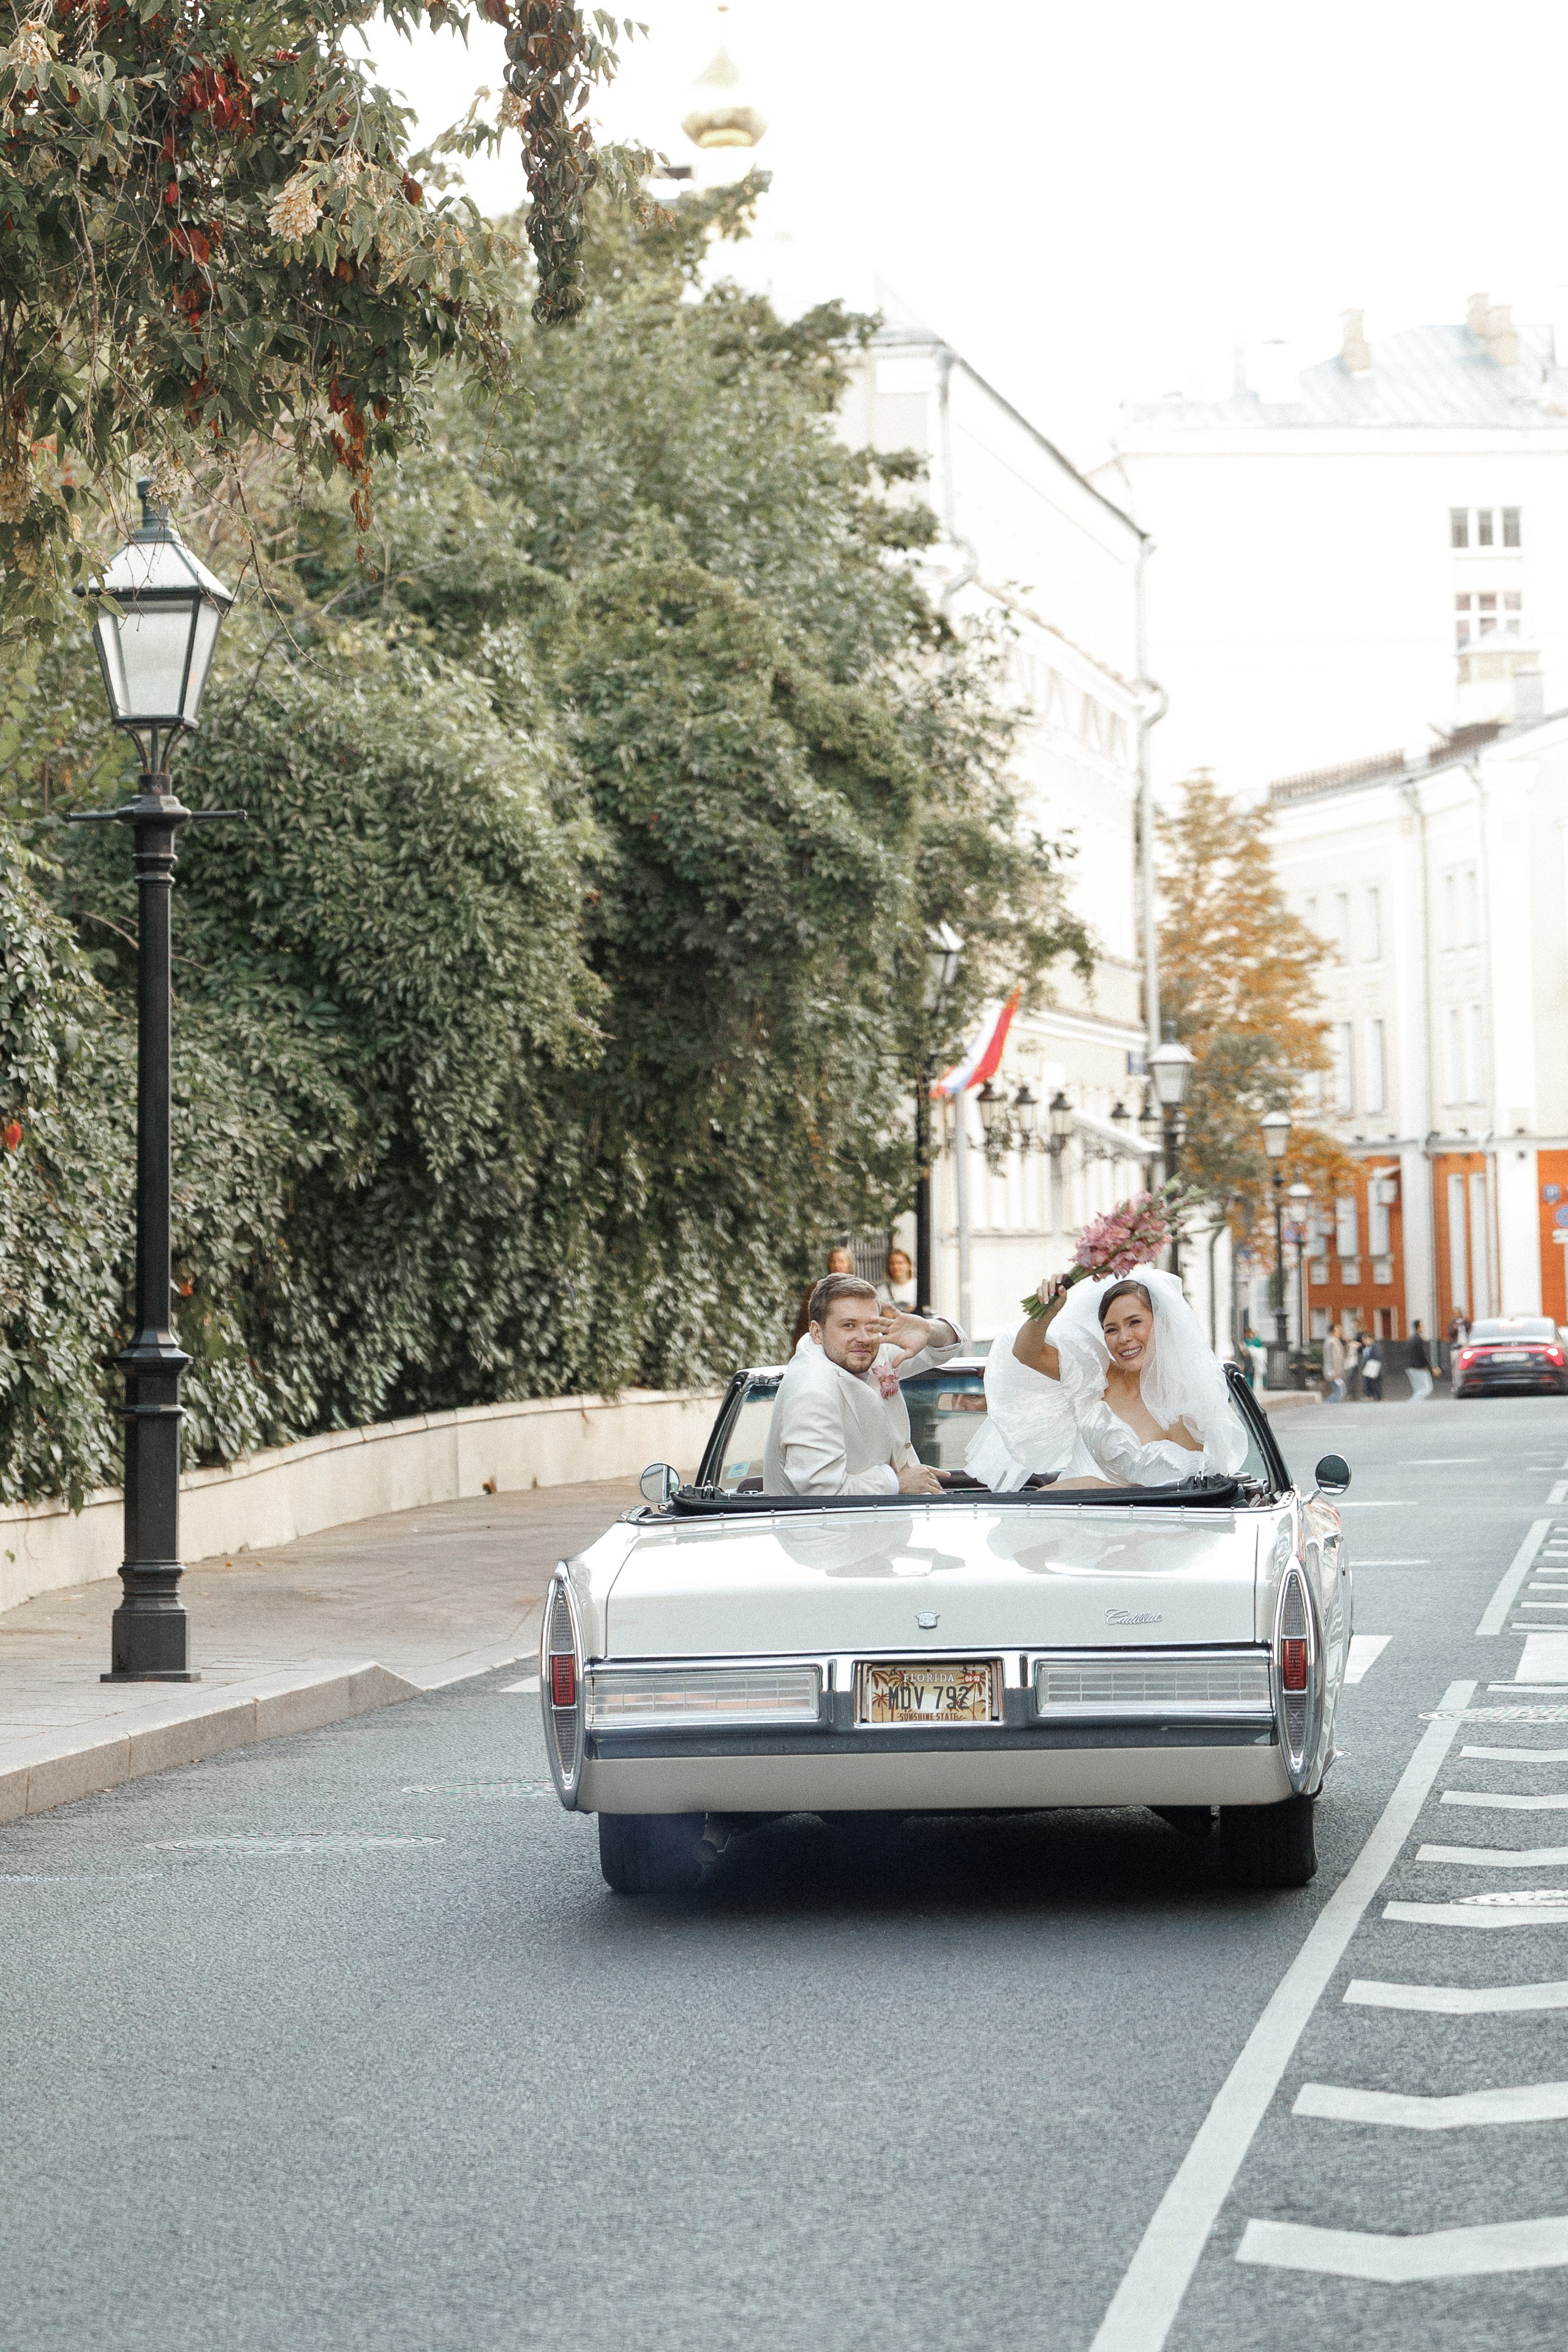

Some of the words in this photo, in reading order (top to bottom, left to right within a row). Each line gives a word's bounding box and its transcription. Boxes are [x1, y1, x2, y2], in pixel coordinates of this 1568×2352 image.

[1104, 1609, 1162, 1625] Cadillac
[903, 1673, 954, 1683] FLORIDA
[888, 1686, 924, 1709] MDV
[932, 1686, 969, 1709] 792
